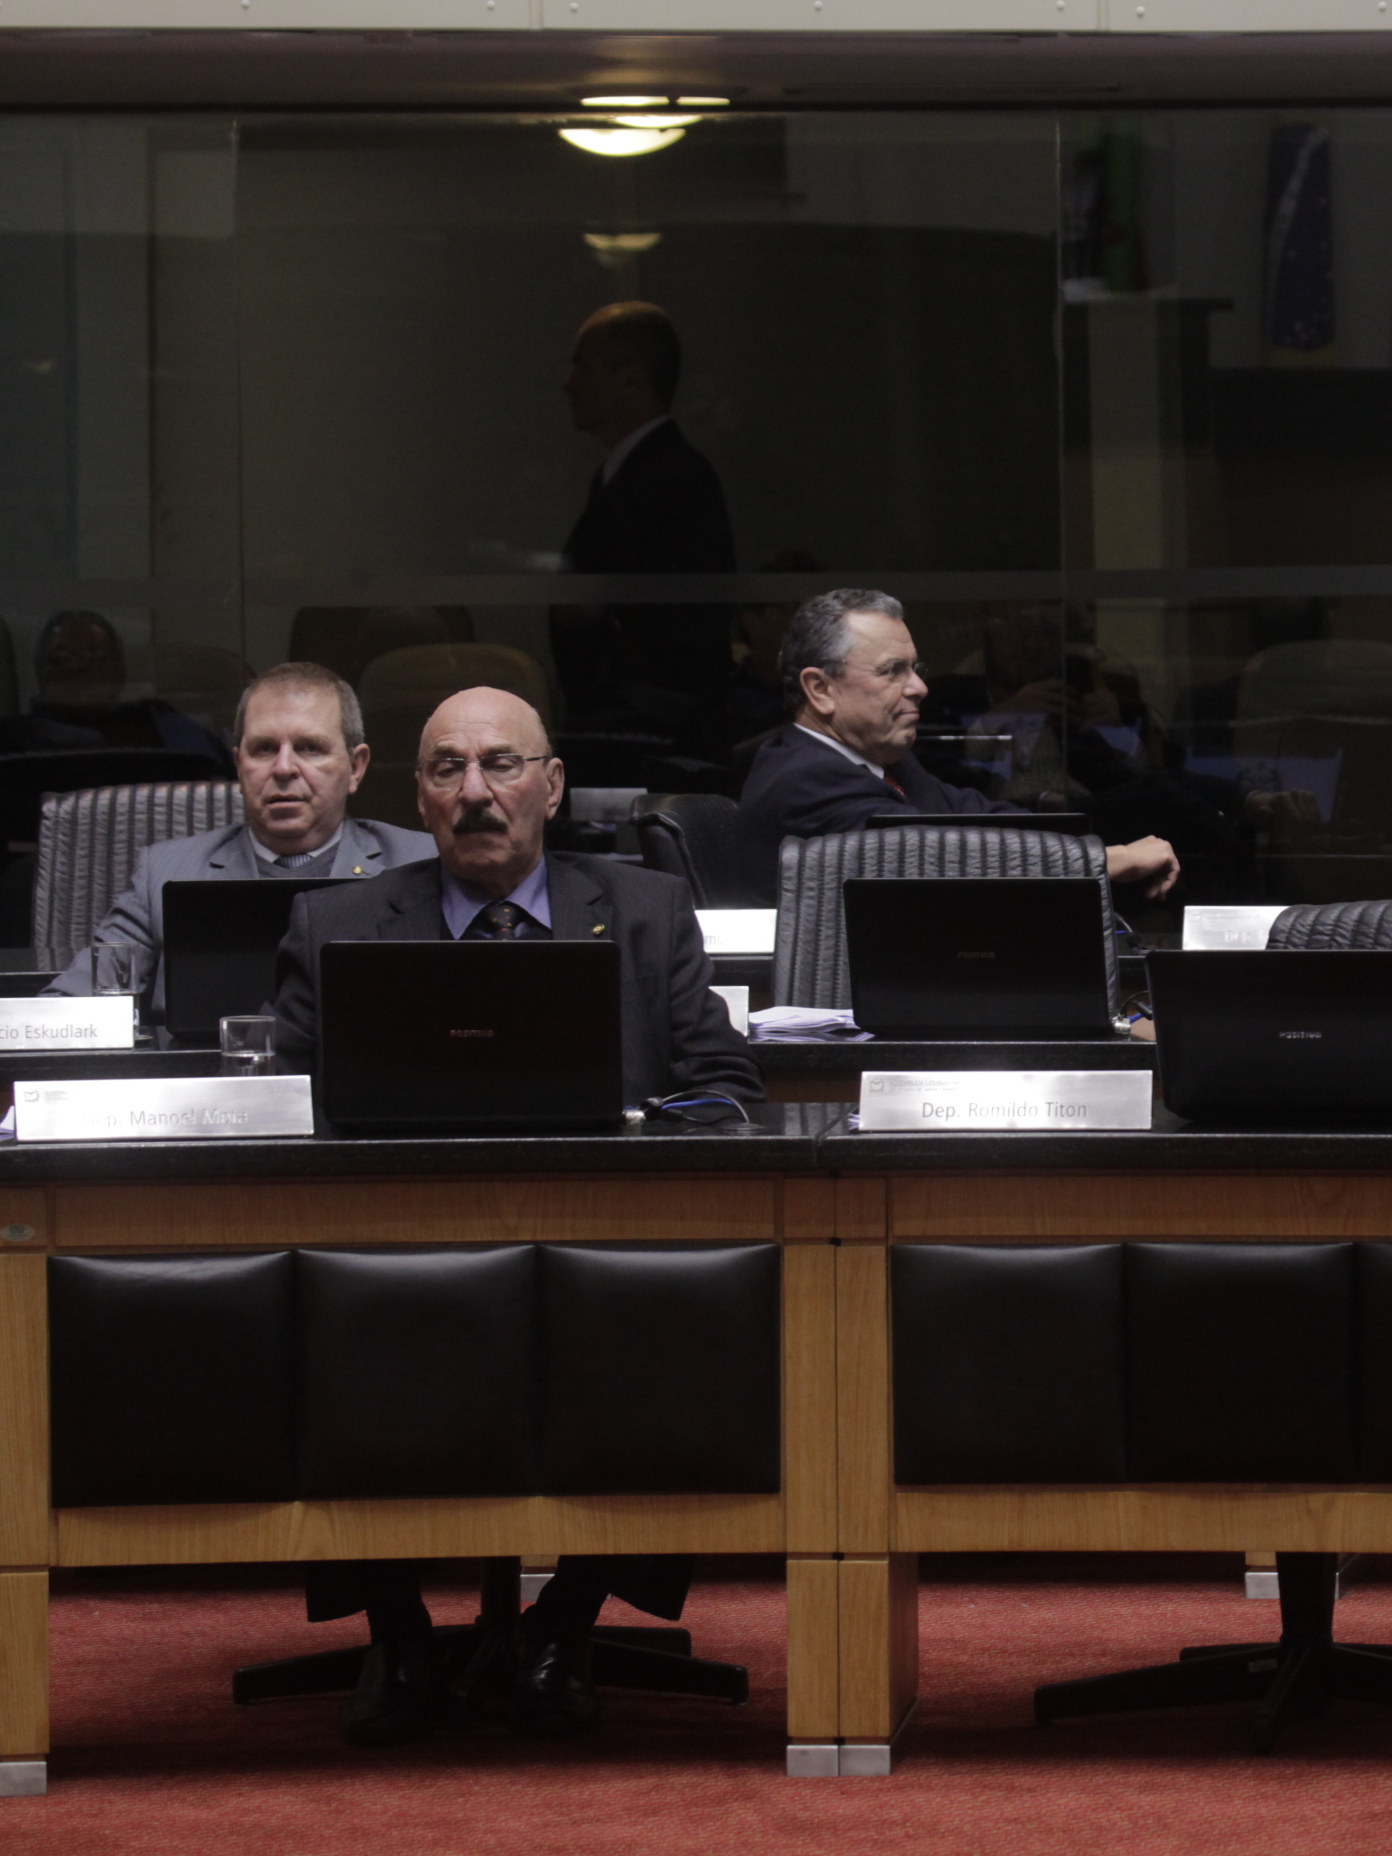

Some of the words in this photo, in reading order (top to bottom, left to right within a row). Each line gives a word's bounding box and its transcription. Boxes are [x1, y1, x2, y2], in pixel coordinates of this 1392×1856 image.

[25, 1024, 98, 1039] Eskudlark
[130, 1108, 196, 1126] Manoel
[202, 1108, 249, 1125] Mota
[921, 1102, 961, 1121] Dep.
[968, 1102, 1038, 1118] Romildo
[1045, 1102, 1088, 1118] Titon
